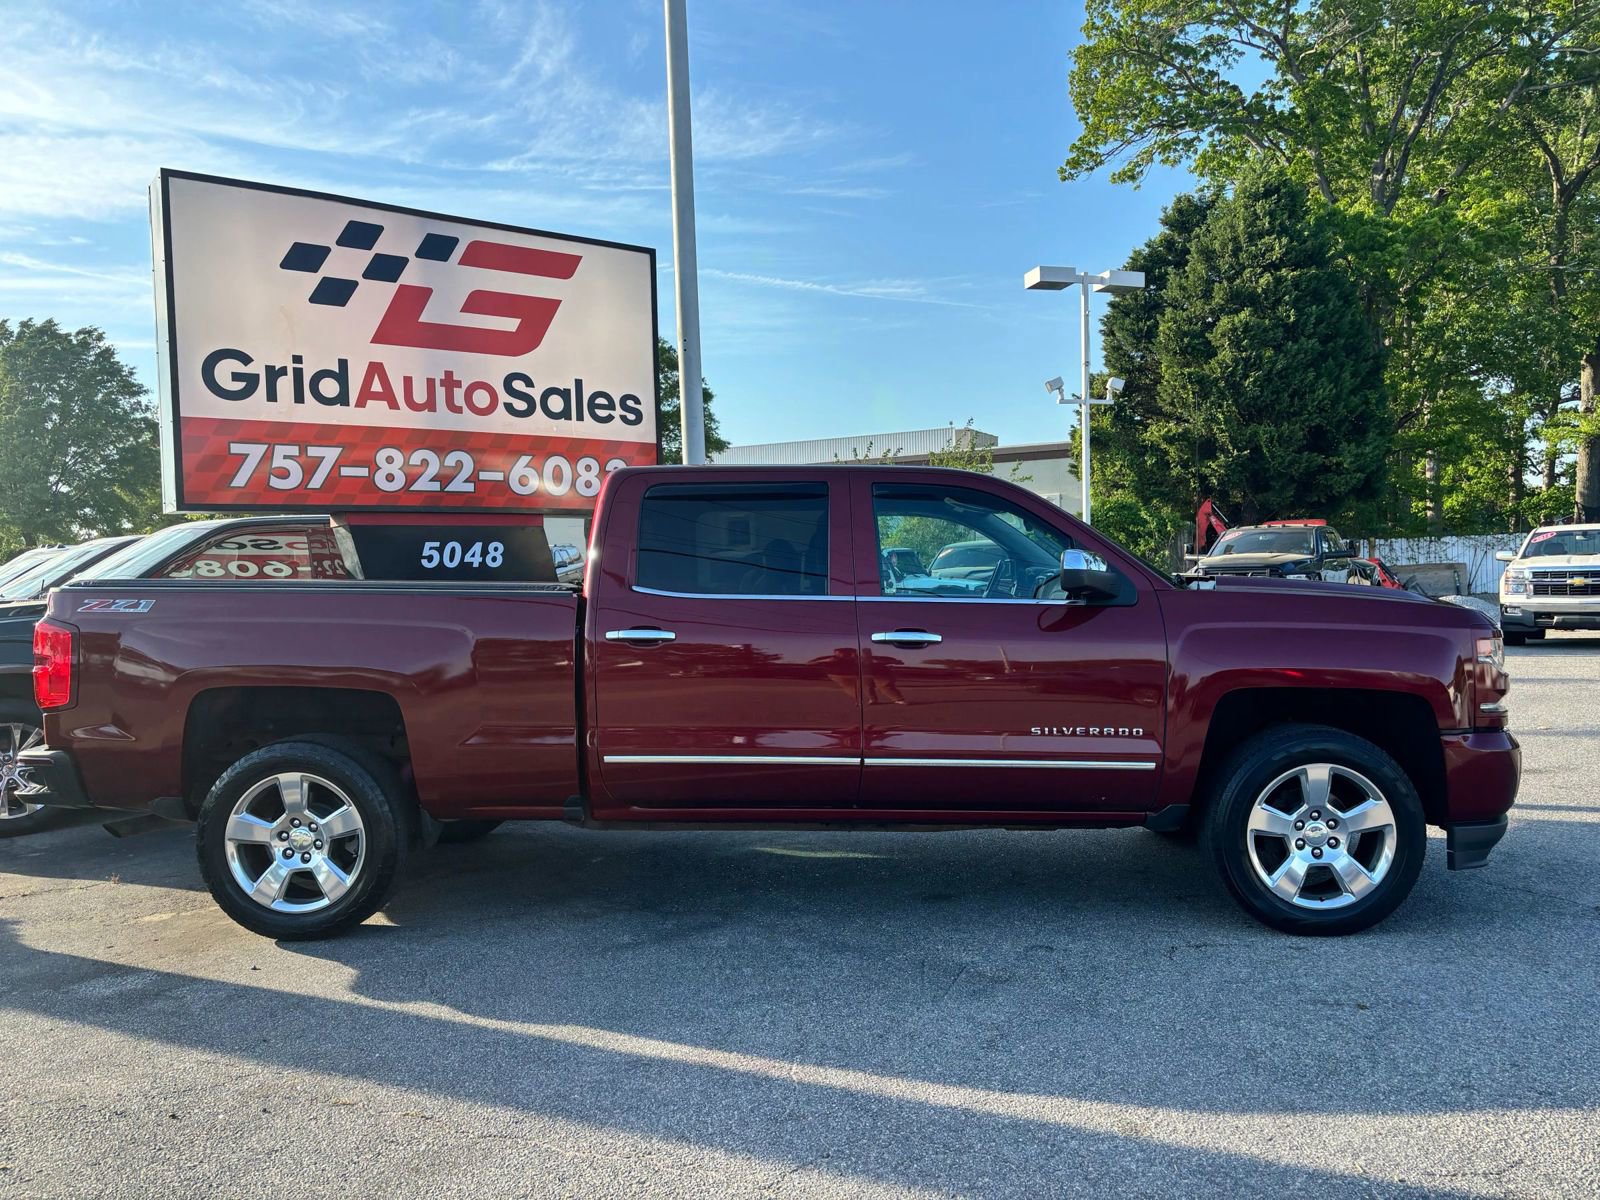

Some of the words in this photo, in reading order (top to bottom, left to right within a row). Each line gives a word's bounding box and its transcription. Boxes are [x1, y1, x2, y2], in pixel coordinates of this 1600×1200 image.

[201, 347, 643, 426] GridAutoSales
[228, 442, 628, 497] 757-822-608
[421, 541, 504, 568] 5048
[77, 599, 156, 613] Z71
[1030, 727, 1144, 736] SILVERADO
